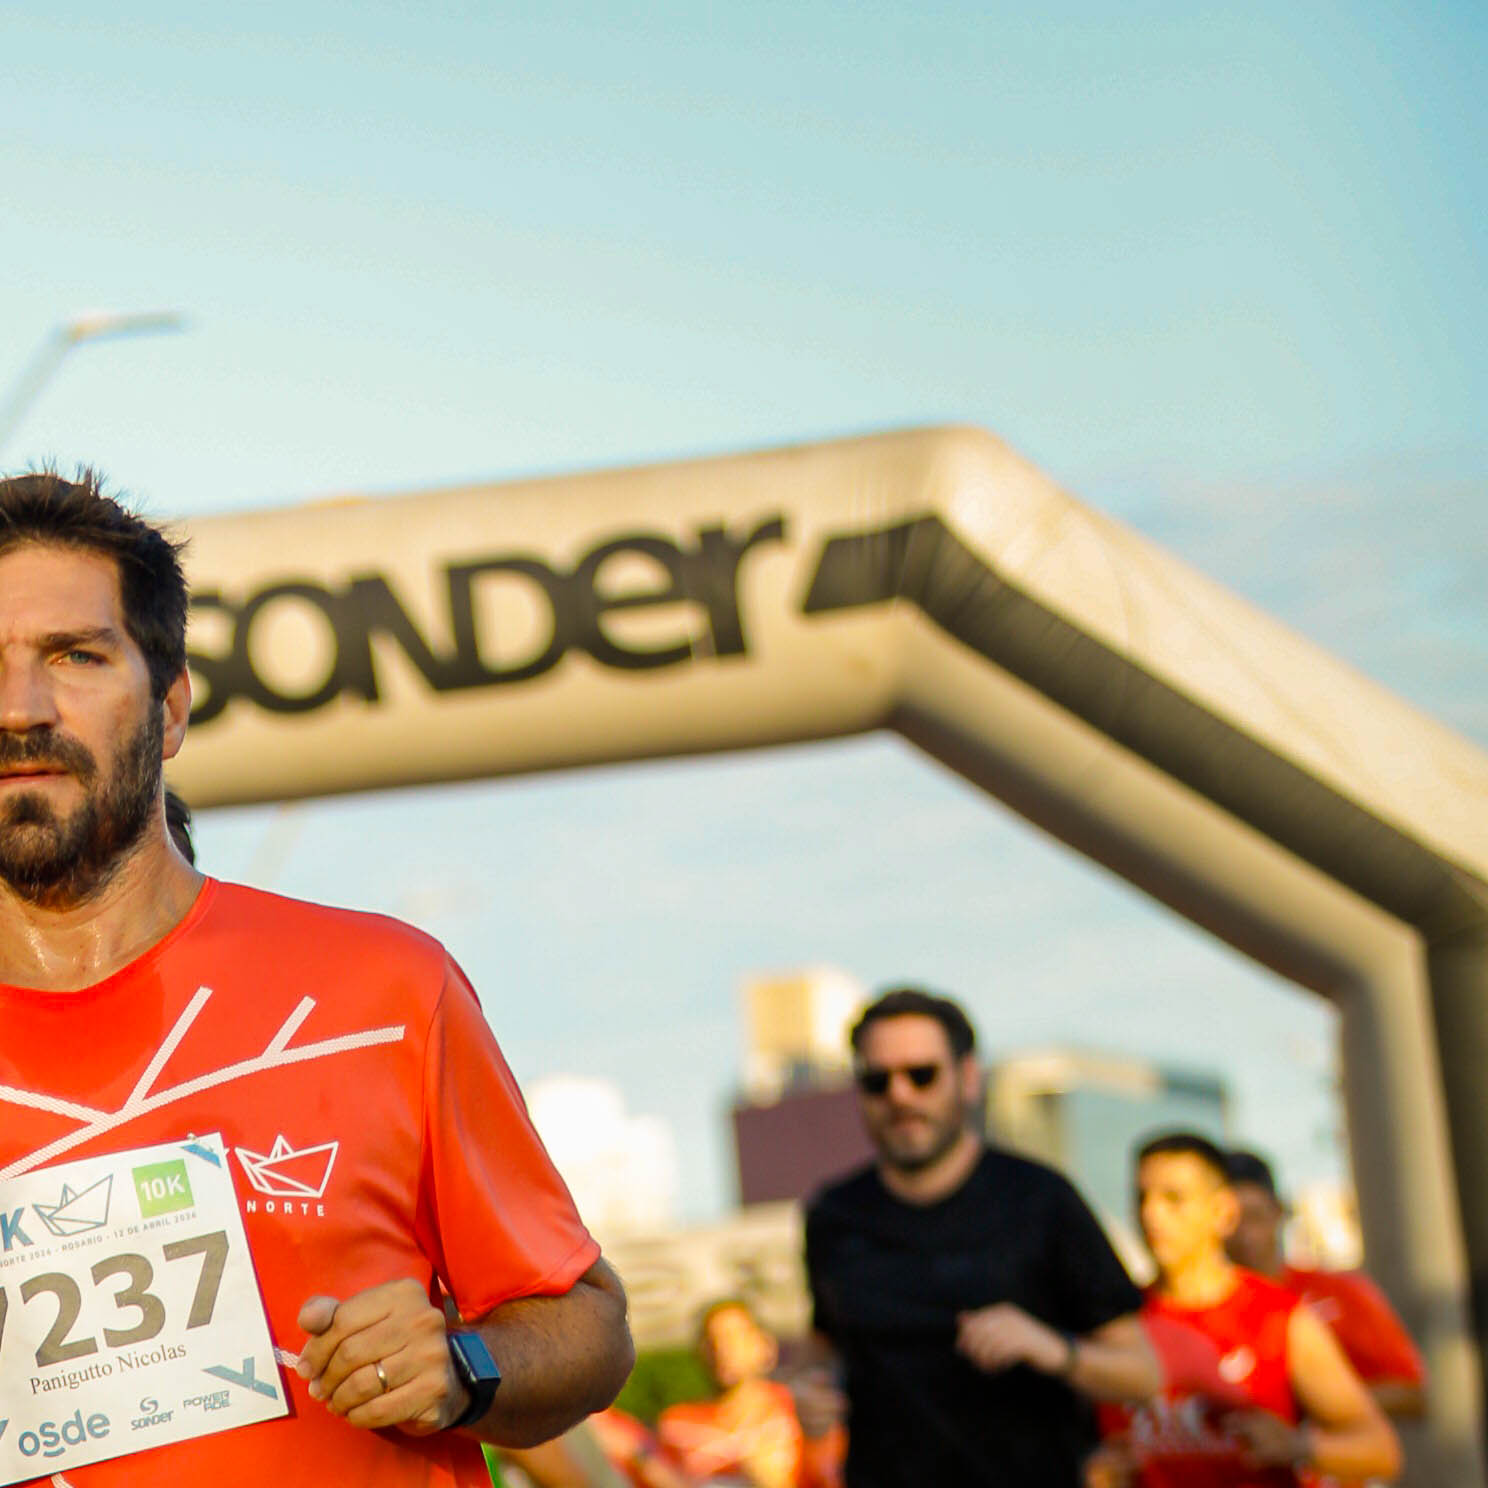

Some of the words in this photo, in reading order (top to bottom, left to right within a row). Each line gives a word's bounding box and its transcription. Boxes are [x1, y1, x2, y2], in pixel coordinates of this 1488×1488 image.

[139, 1173, 186, 1202] 10K
[246, 1200, 325, 1217] NORTE
[61, 1234, 104, 1252] ROSARIO
[114, 1230, 124, 1239] 12
[127, 1225, 139, 1236] DE
[143, 1218, 170, 1230] ABRIL
[29, 1360, 112, 1395] Panigutto
[117, 1343, 187, 1373] Nicolas
[183, 1390, 230, 1408] POWER
[18, 1408, 111, 1458] osde
